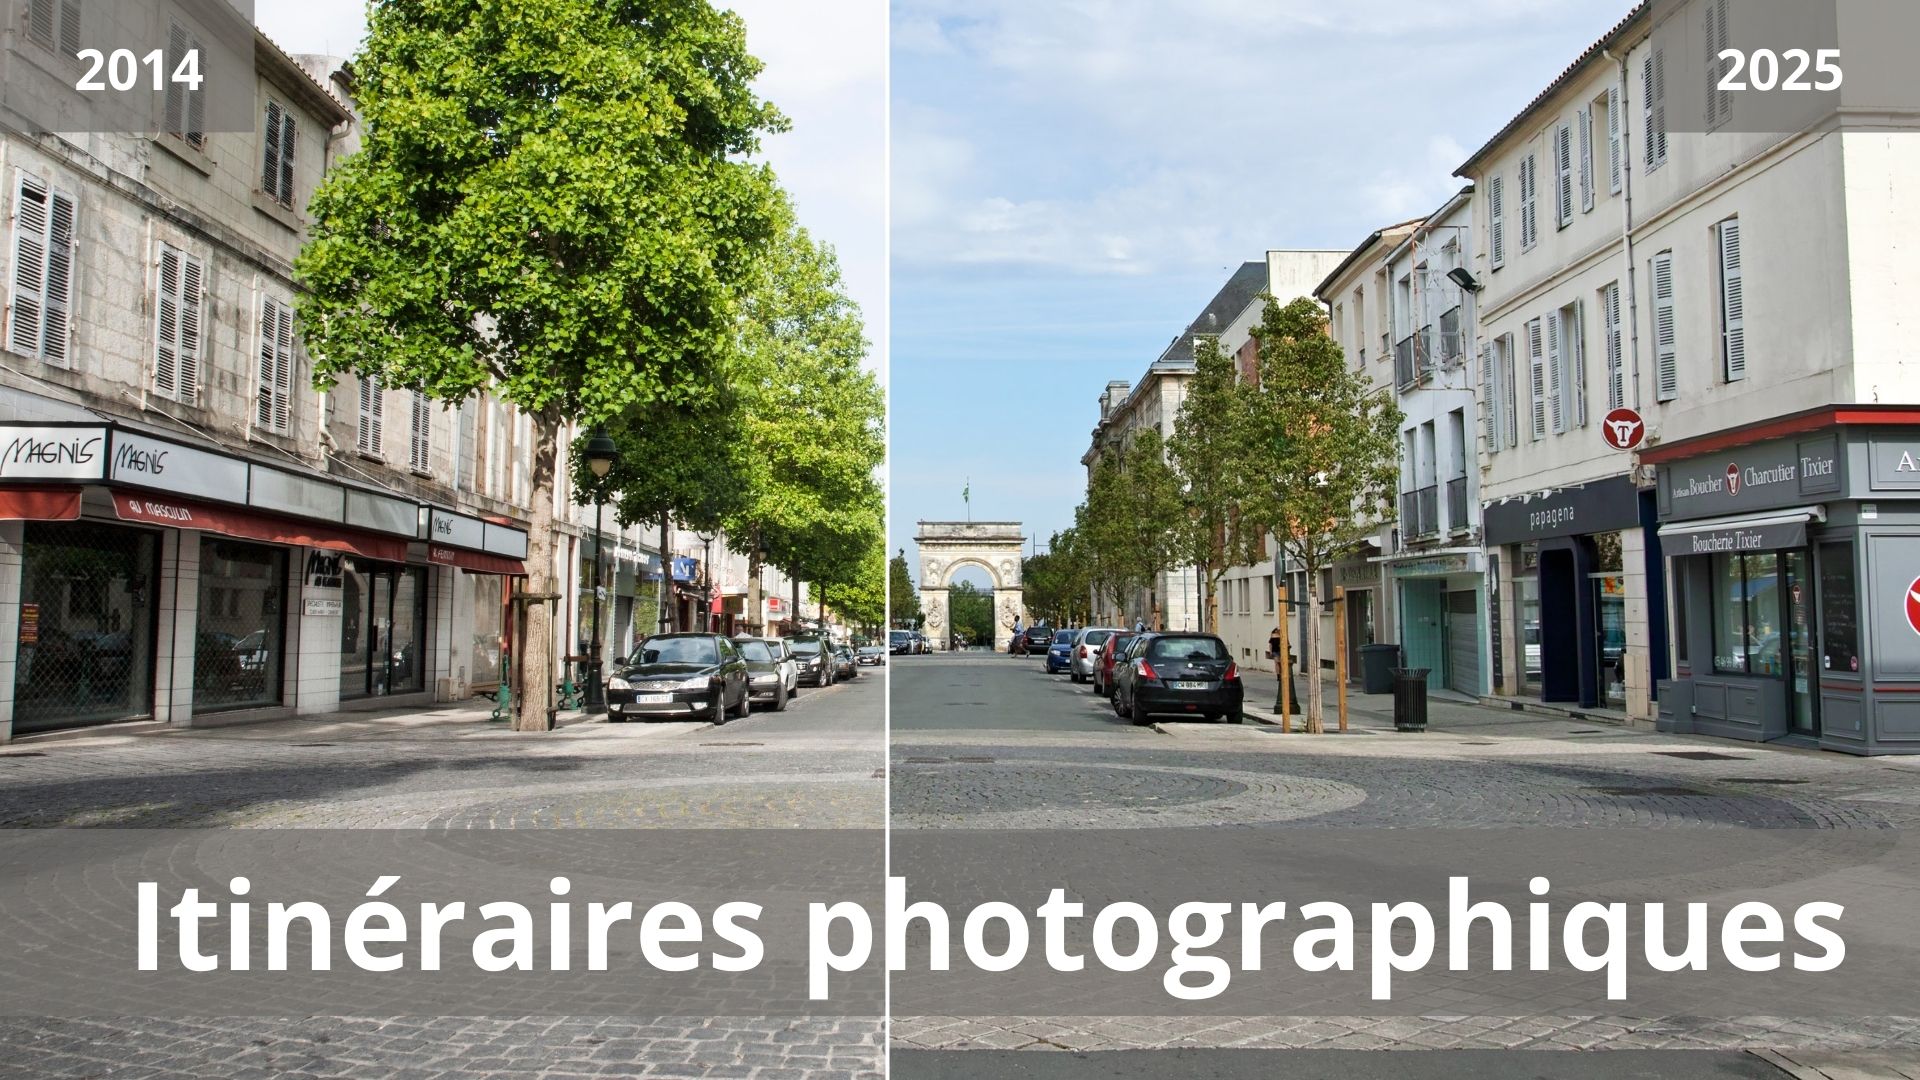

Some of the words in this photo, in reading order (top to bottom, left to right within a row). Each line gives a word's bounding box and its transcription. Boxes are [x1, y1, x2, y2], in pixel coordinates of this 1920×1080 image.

[1689, 475, 1723, 496] Boucher
[1744, 464, 1796, 487] Charcutier
[1800, 456, 1834, 478] Tixier
[145, 502, 193, 521] MASCULIN
[1530, 506, 1574, 531] papagena
[1692, 532, 1733, 552] Boucherie
[1735, 530, 1762, 550] Tixier
